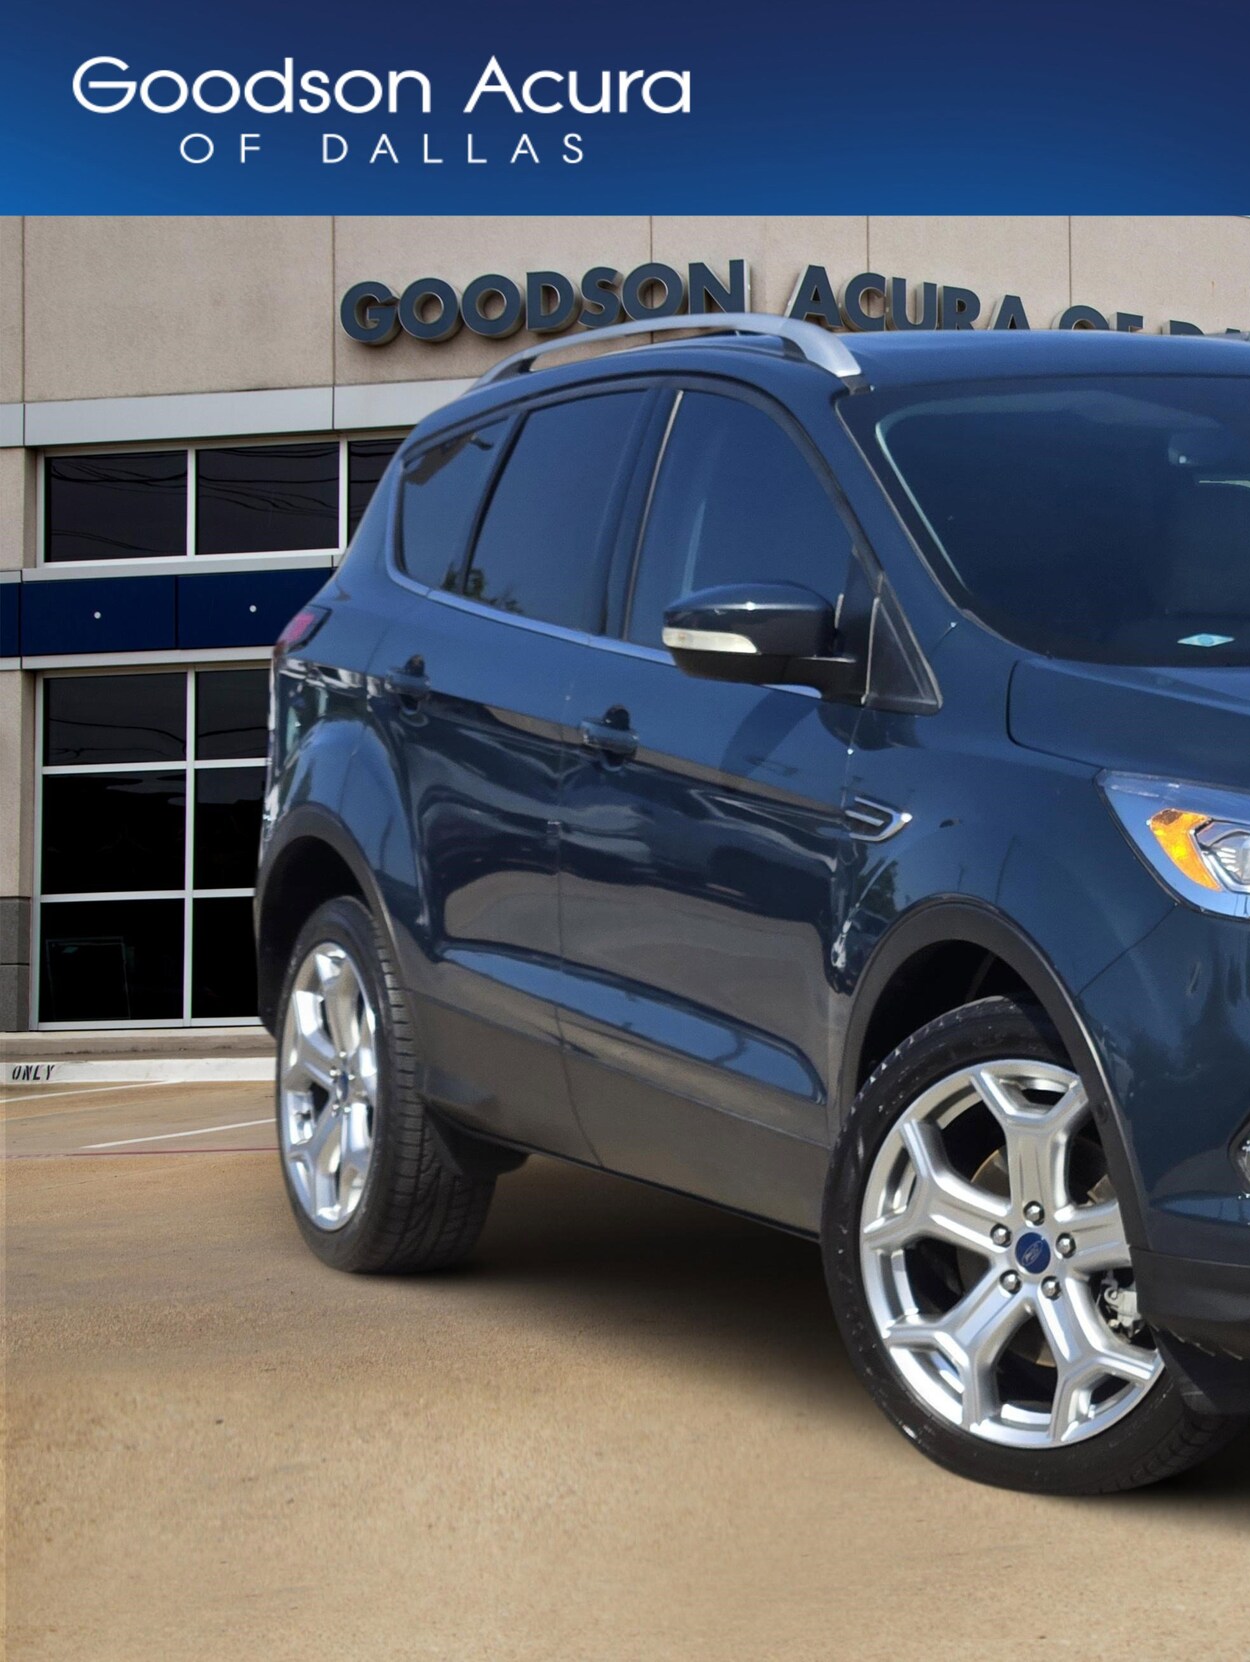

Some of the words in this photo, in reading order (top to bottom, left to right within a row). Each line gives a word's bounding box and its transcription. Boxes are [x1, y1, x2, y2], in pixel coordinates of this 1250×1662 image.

[339, 258, 750, 345] GOODSON
[784, 264, 1031, 332] ACURA
[11, 1064, 55, 1081] ONLY
